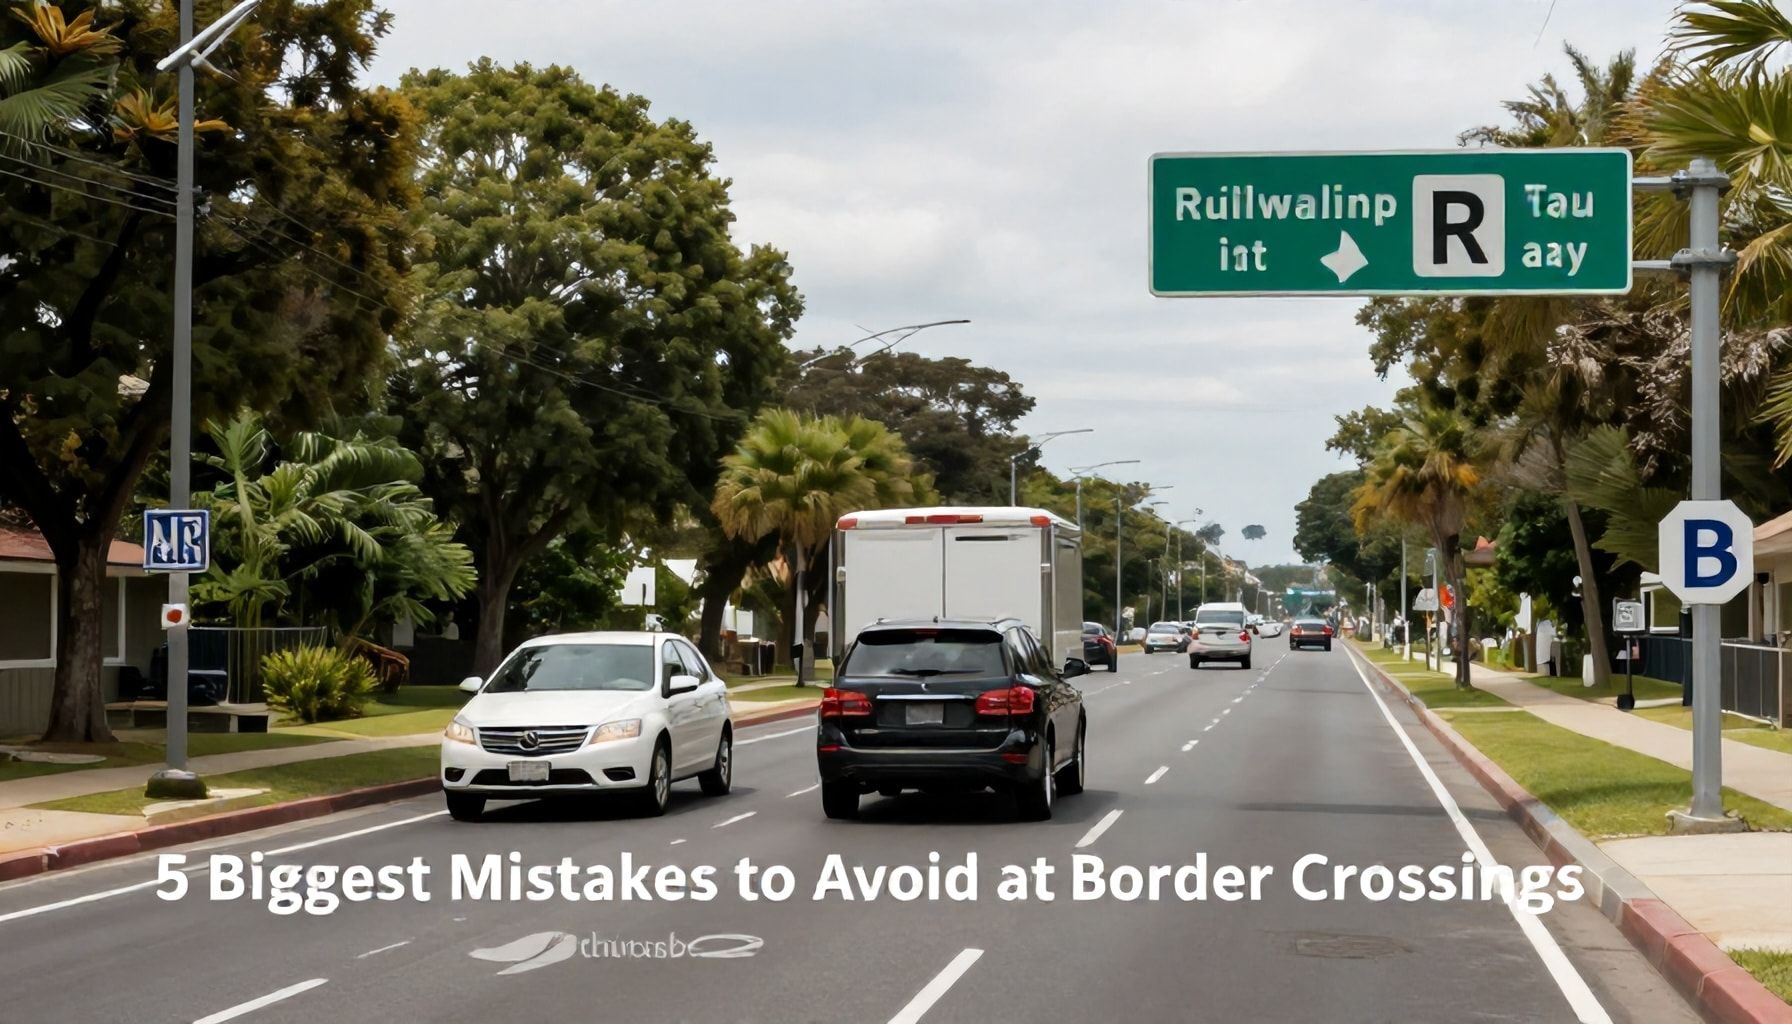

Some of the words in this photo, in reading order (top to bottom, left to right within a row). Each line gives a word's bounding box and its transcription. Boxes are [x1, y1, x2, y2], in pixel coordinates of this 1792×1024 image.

[1524, 183, 1594, 218] Tau
[1433, 190, 1488, 264] R
[1521, 241, 1588, 277] aay
[1684, 519, 1738, 588] B
